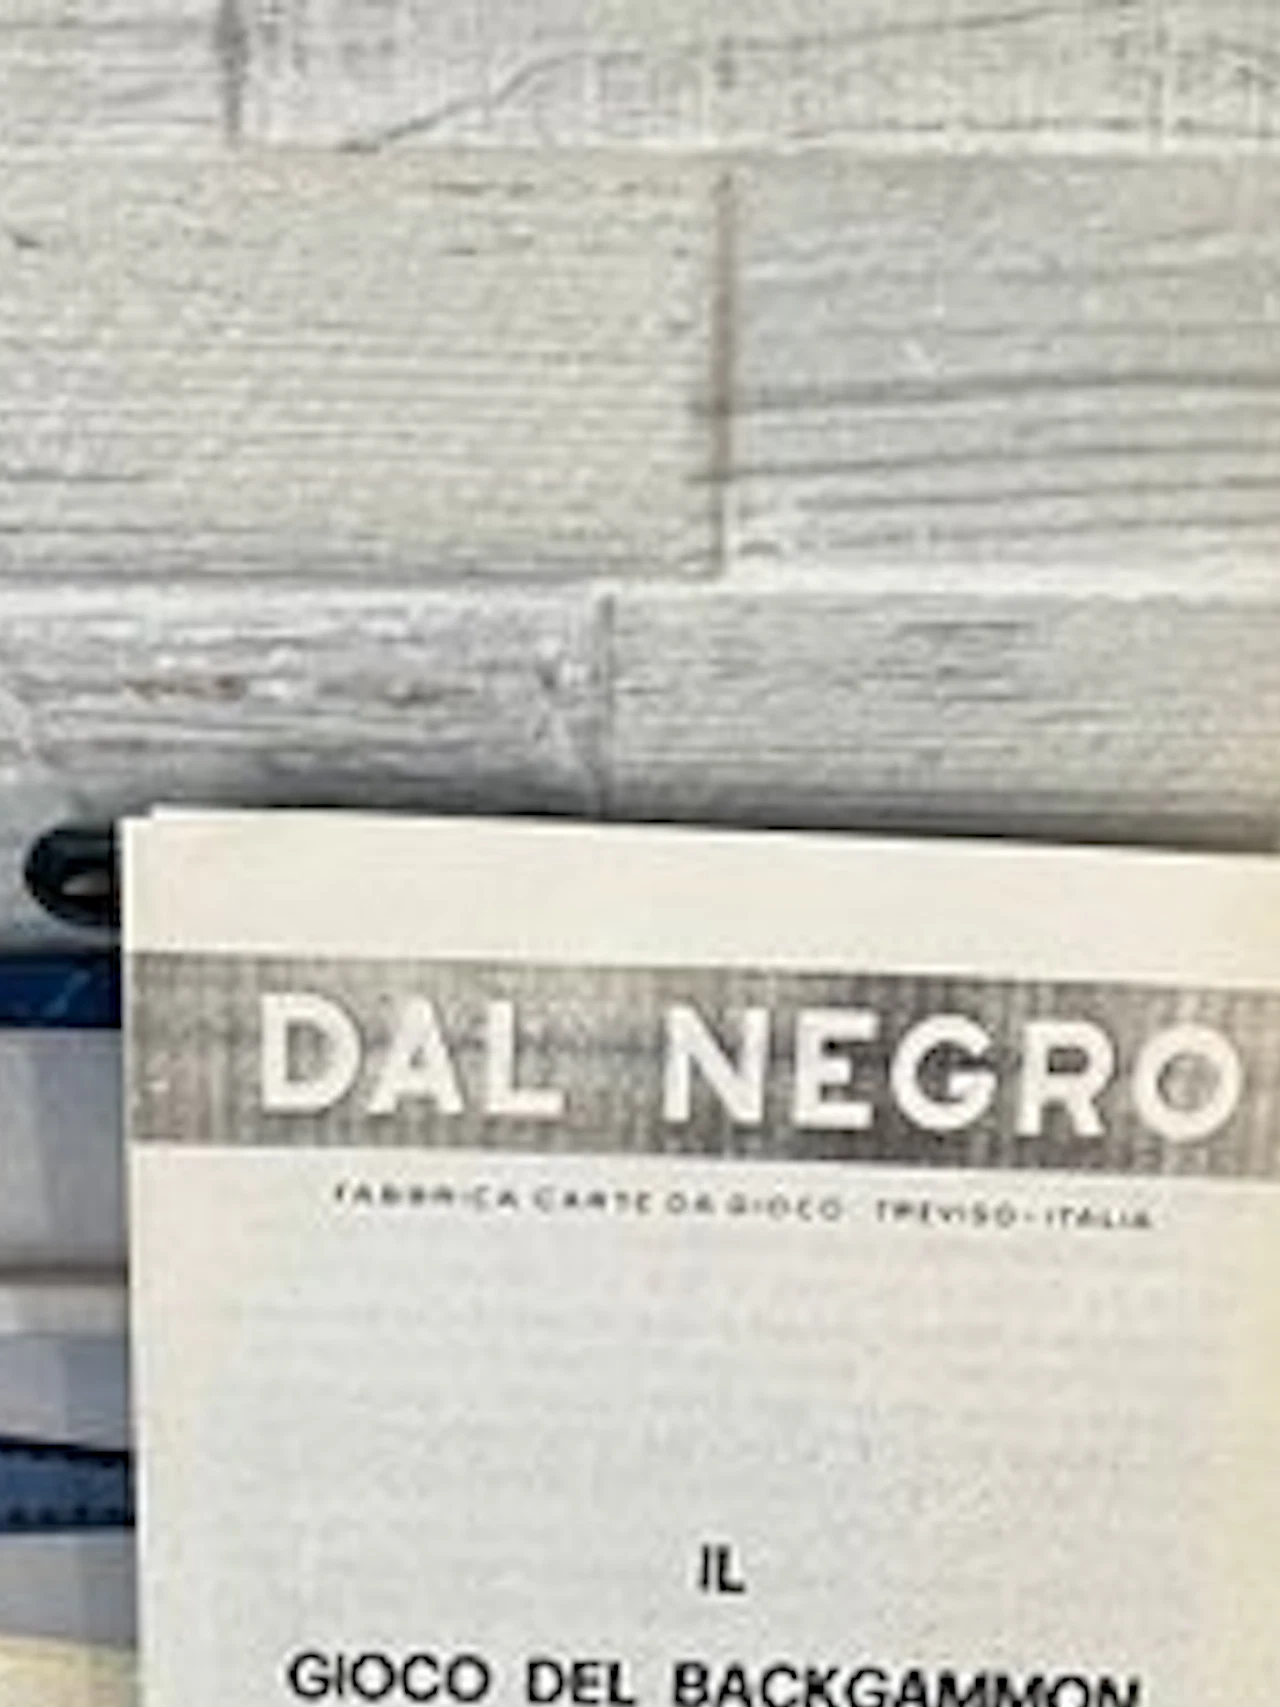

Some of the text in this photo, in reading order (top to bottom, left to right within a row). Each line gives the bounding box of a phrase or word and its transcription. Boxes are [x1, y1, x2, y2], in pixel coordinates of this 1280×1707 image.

[258, 993, 1244, 1143] DAL NEGRO
[533, 1187, 651, 1213] CARTE
[727, 1196, 842, 1221] GIOCO
[699, 1545, 745, 1593] IL
[286, 1651, 490, 1703] GIOCO
[526, 1658, 636, 1707] DEL
